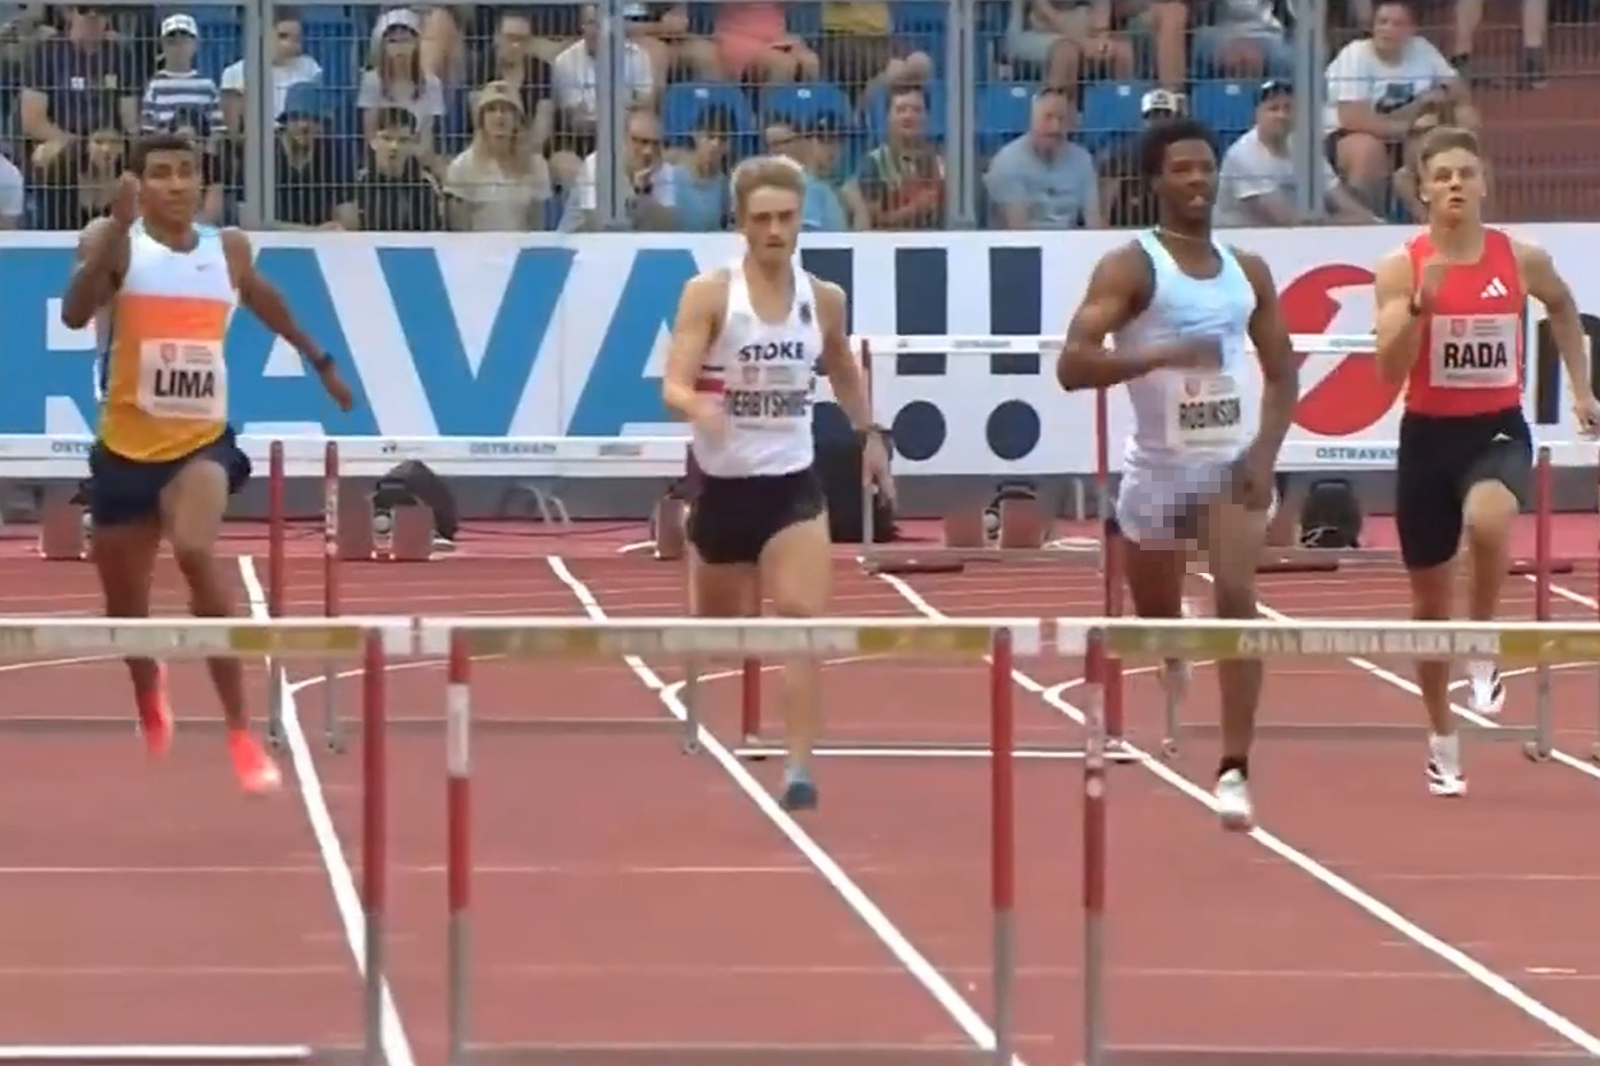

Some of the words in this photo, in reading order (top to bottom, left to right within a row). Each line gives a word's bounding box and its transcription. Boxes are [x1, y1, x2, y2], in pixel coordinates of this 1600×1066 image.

[738, 341, 805, 361] STOKE
[1444, 341, 1507, 369] RADA
[154, 368, 214, 398] LIMA
